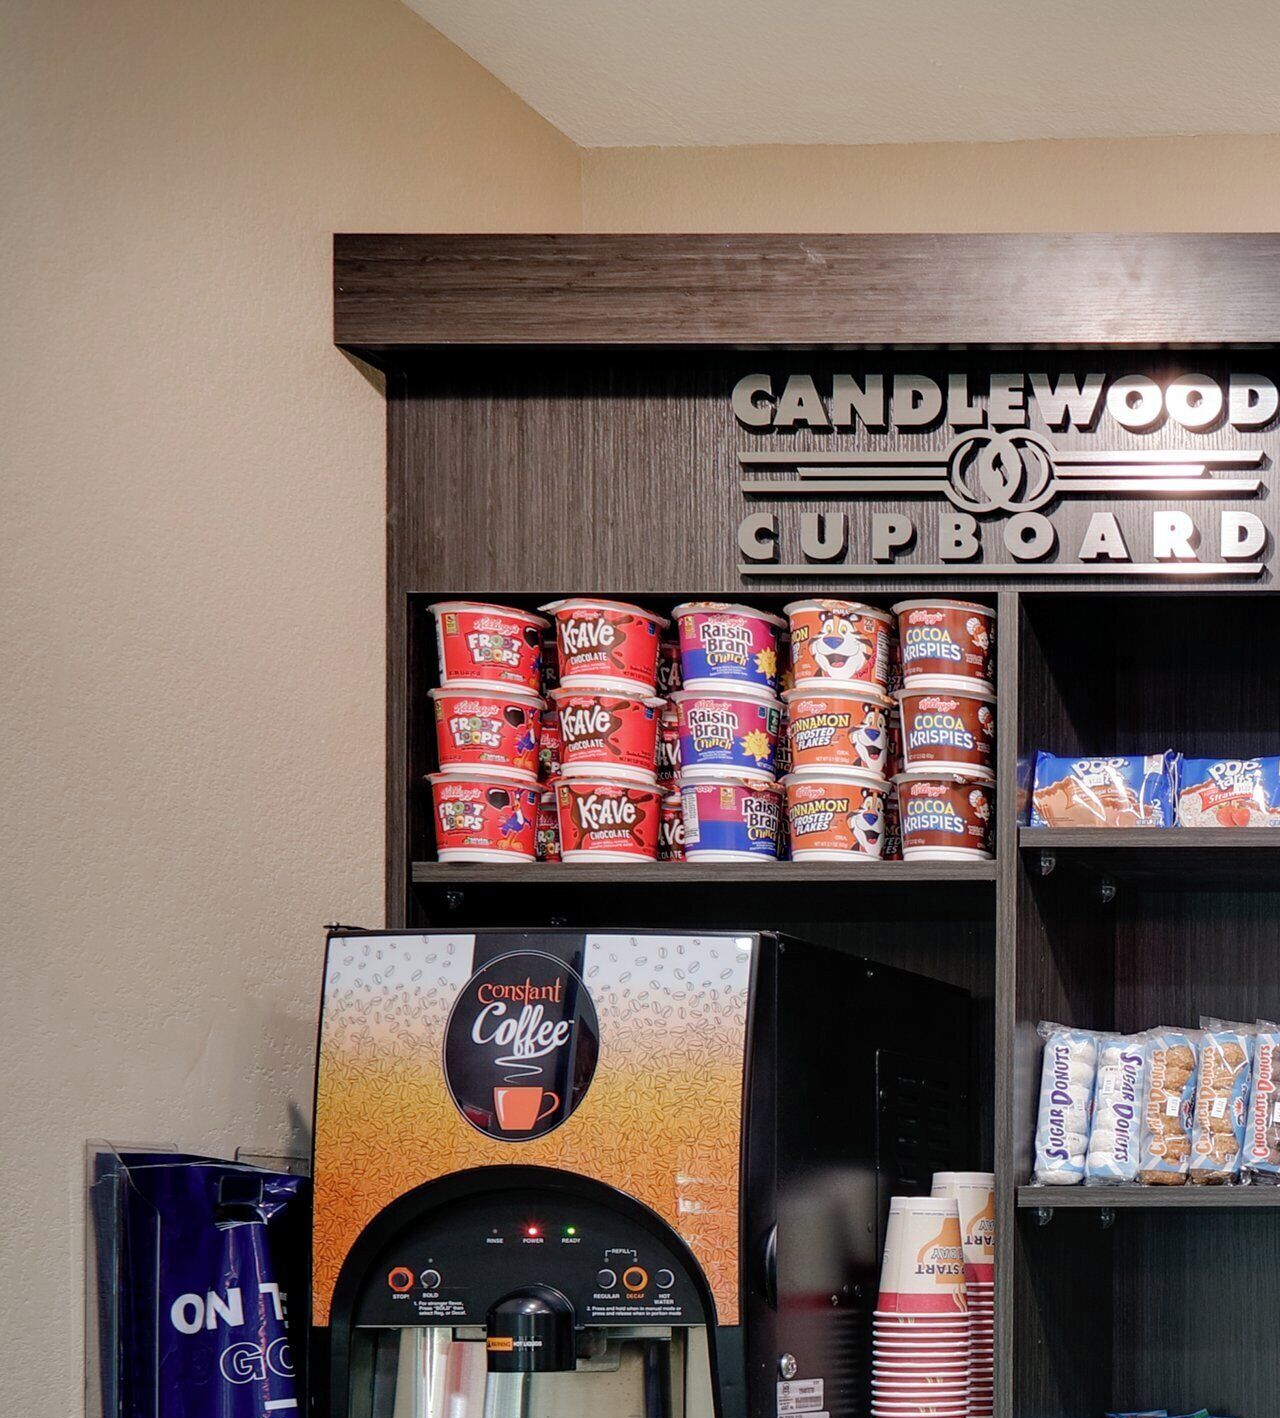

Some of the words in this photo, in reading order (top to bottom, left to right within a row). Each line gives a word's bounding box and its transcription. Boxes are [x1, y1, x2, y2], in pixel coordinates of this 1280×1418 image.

[731, 373, 1280, 432] CANDLEWOOD
[738, 511, 1272, 563] CUPBOARD
[701, 624, 752, 644] Raisin
[906, 627, 952, 644] COCOA
[705, 638, 748, 655] Bran
[903, 641, 962, 661] KRISPIES
[570, 651, 608, 664] CHOCOLATE
[688, 708, 738, 728] Raisin
[914, 715, 965, 731] COCOA
[693, 722, 735, 741] Bran
[796, 727, 836, 741] FROSTED
[910, 731, 974, 750] KRISPIES
[798, 736, 832, 749] FLAKES
[590, 829, 631, 840] CHOCOLATE
[471, 1002, 571, 1057] Coffee
[1051, 1045, 1071, 1105] DONUTS
[1257, 1045, 1274, 1092] DONUTS
[1046, 1105, 1069, 1160] SUGAR
[170, 1287, 244, 1335] ON
